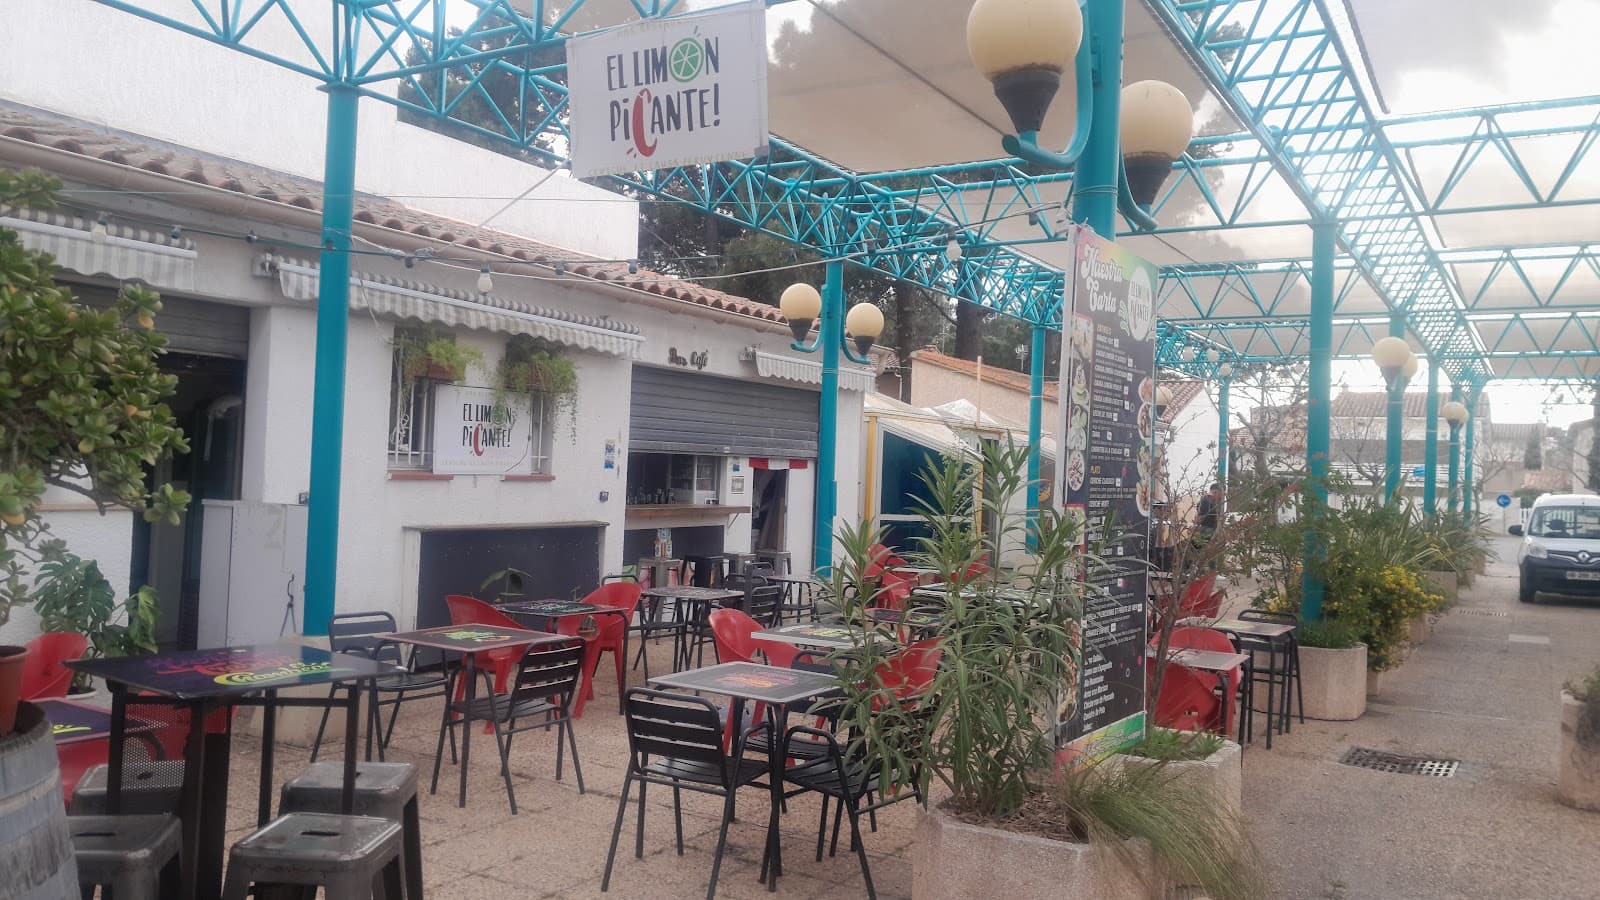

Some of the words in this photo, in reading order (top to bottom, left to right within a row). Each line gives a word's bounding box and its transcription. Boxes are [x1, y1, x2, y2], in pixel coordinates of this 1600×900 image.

[606, 54, 628, 91] EL
[1081, 243, 1123, 283] Nuestra
[1086, 276, 1117, 312] Carta
[463, 403, 472, 422] EL
